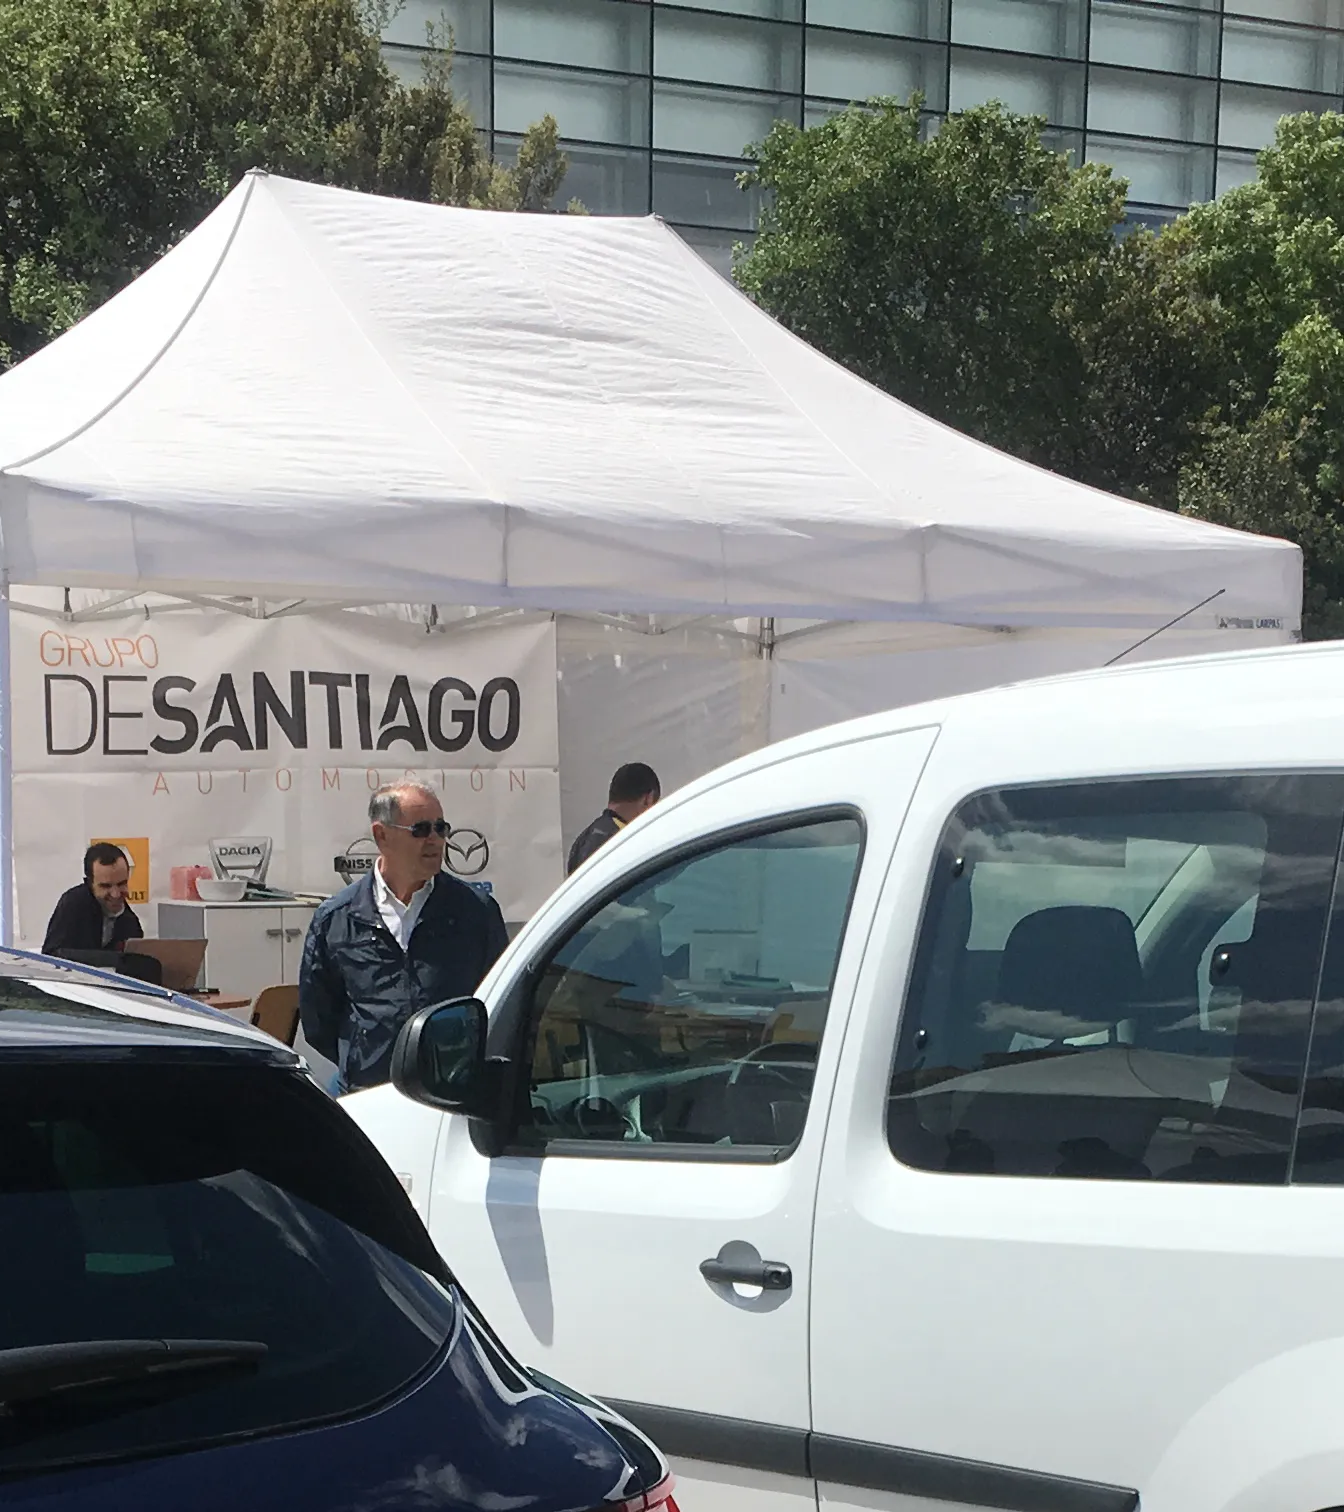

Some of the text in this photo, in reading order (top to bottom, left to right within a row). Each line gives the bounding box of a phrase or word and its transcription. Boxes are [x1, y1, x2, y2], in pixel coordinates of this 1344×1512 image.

[40, 631, 158, 668] GRUPO
[219, 846, 261, 856] DACIA
[341, 859, 373, 869] NISS
